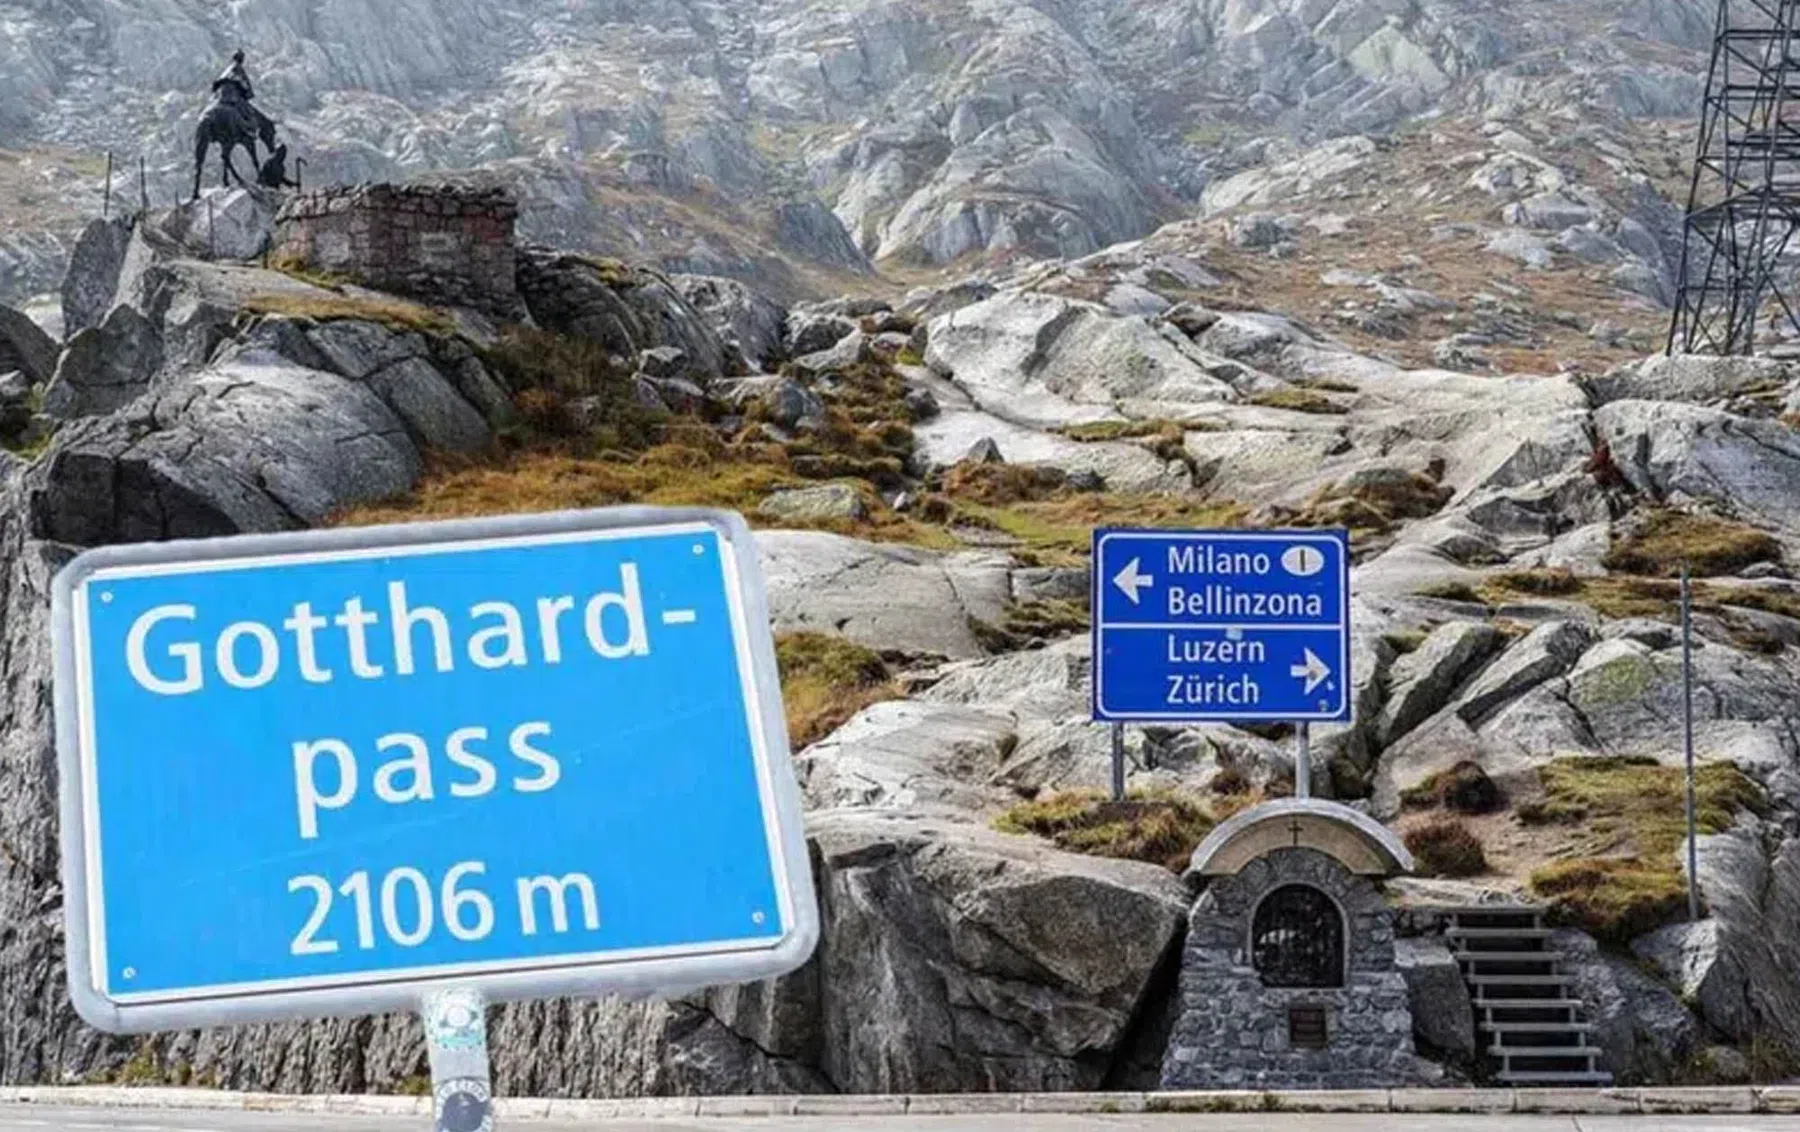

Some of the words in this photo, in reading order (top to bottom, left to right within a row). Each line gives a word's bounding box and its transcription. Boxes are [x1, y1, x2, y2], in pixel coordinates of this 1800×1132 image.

[1168, 546, 1270, 574] Milano
[1168, 585, 1322, 616] Bellinzona
[126, 562, 696, 695] Gotthard-
[1168, 634, 1265, 662] Luzern
[1167, 673, 1260, 704] Zürich
[292, 720, 561, 838] pass
[287, 861, 495, 955] 2106
[517, 869, 600, 936] m
